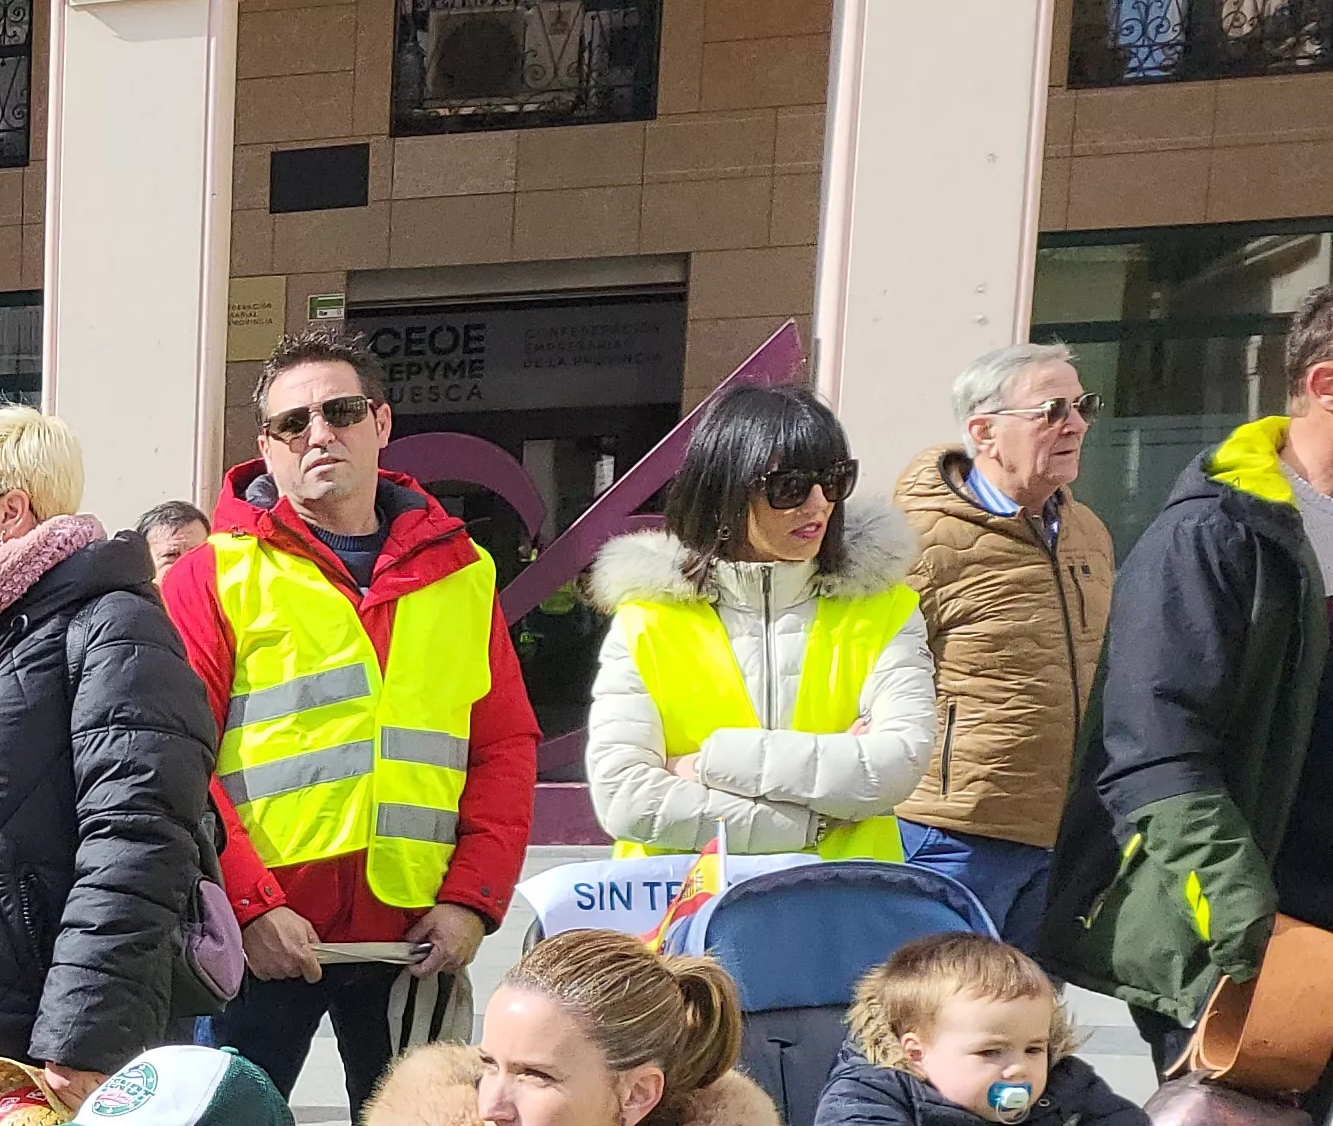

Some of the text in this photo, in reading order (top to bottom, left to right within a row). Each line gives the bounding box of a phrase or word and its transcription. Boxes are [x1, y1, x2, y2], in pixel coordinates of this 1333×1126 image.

[370, 322, 485, 358] CEOE
[381, 358, 484, 383] EPYME
[387, 383, 483, 405] UESCA
[574, 881, 632, 911] SIN
